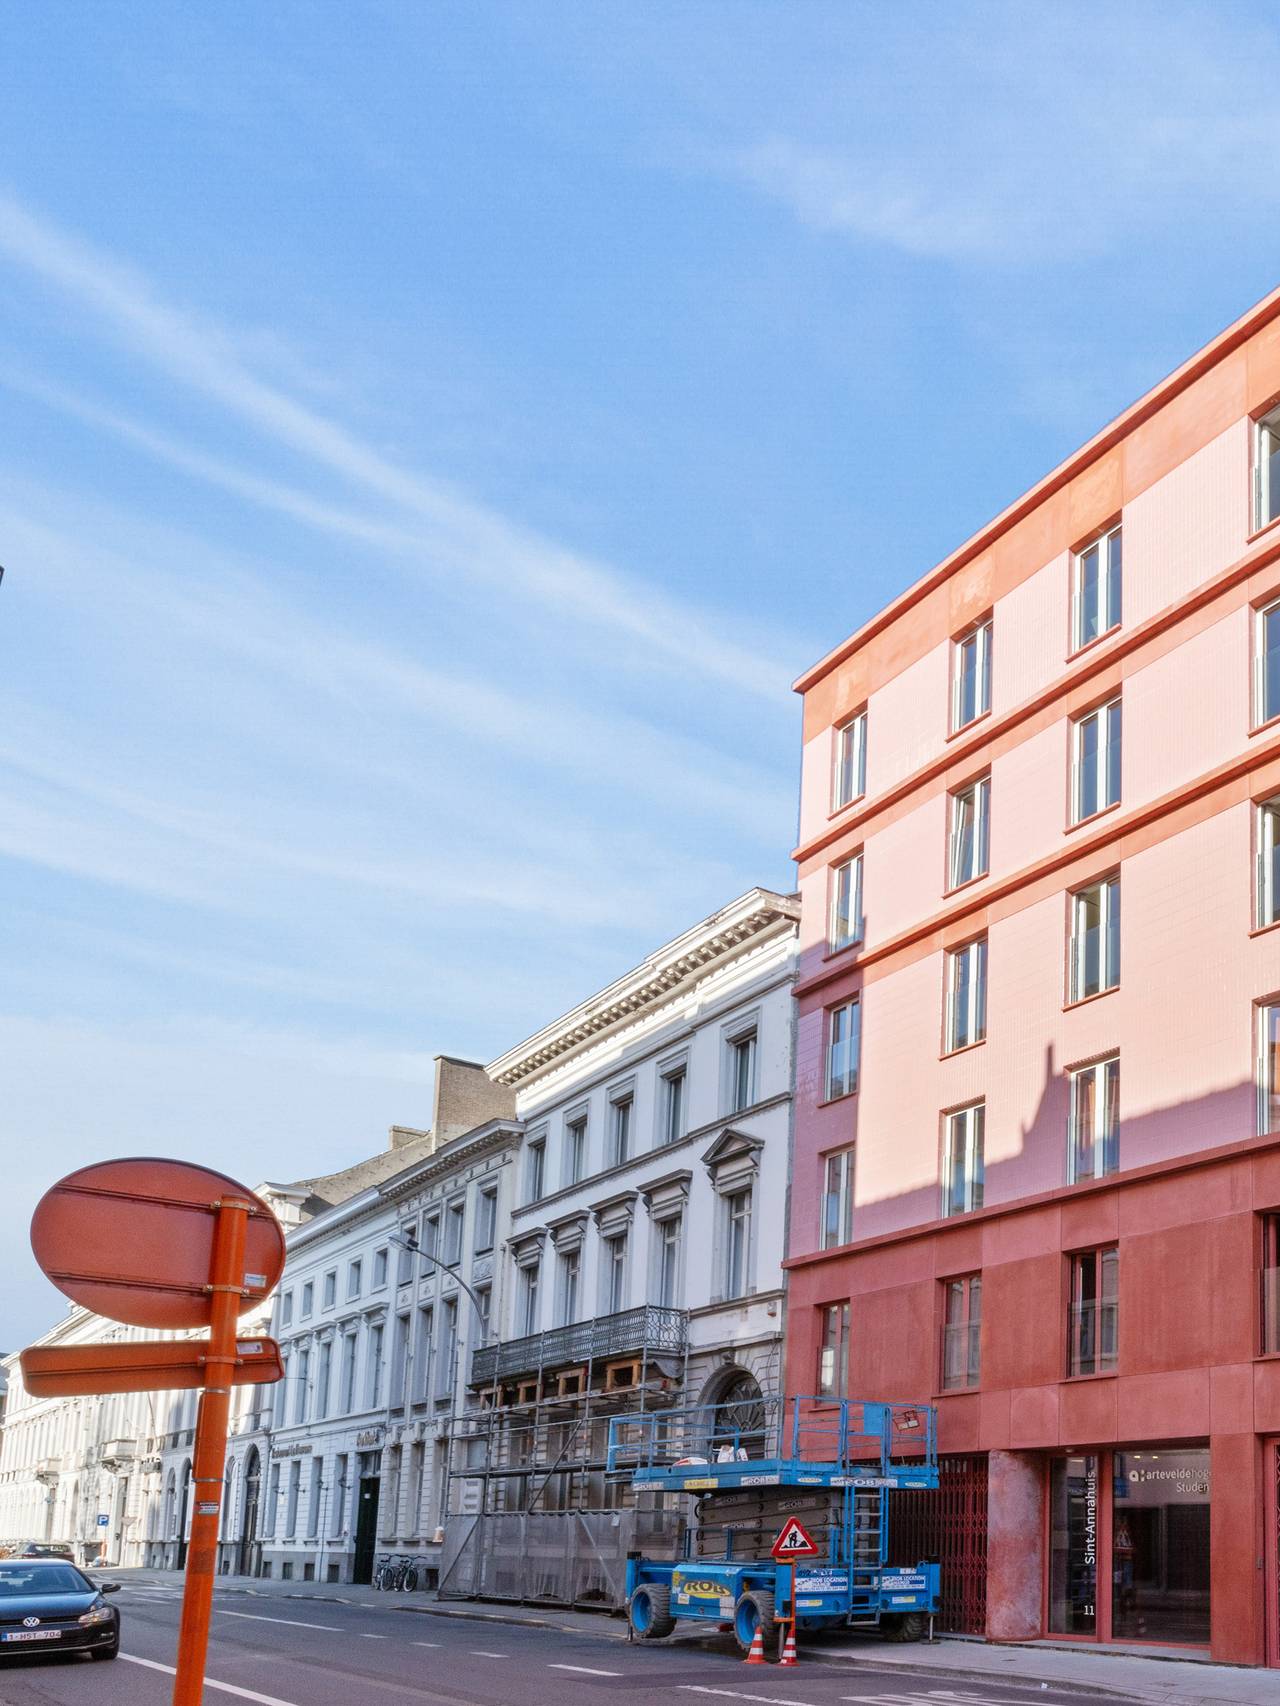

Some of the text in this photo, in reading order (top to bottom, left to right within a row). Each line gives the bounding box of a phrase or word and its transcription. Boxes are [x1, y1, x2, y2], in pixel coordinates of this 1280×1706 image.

[1146, 1468, 1211, 1480] arteveldehog
[1085, 1471, 1096, 1565] Sint-Annahuis
[1084, 1605, 1095, 1616] 11
